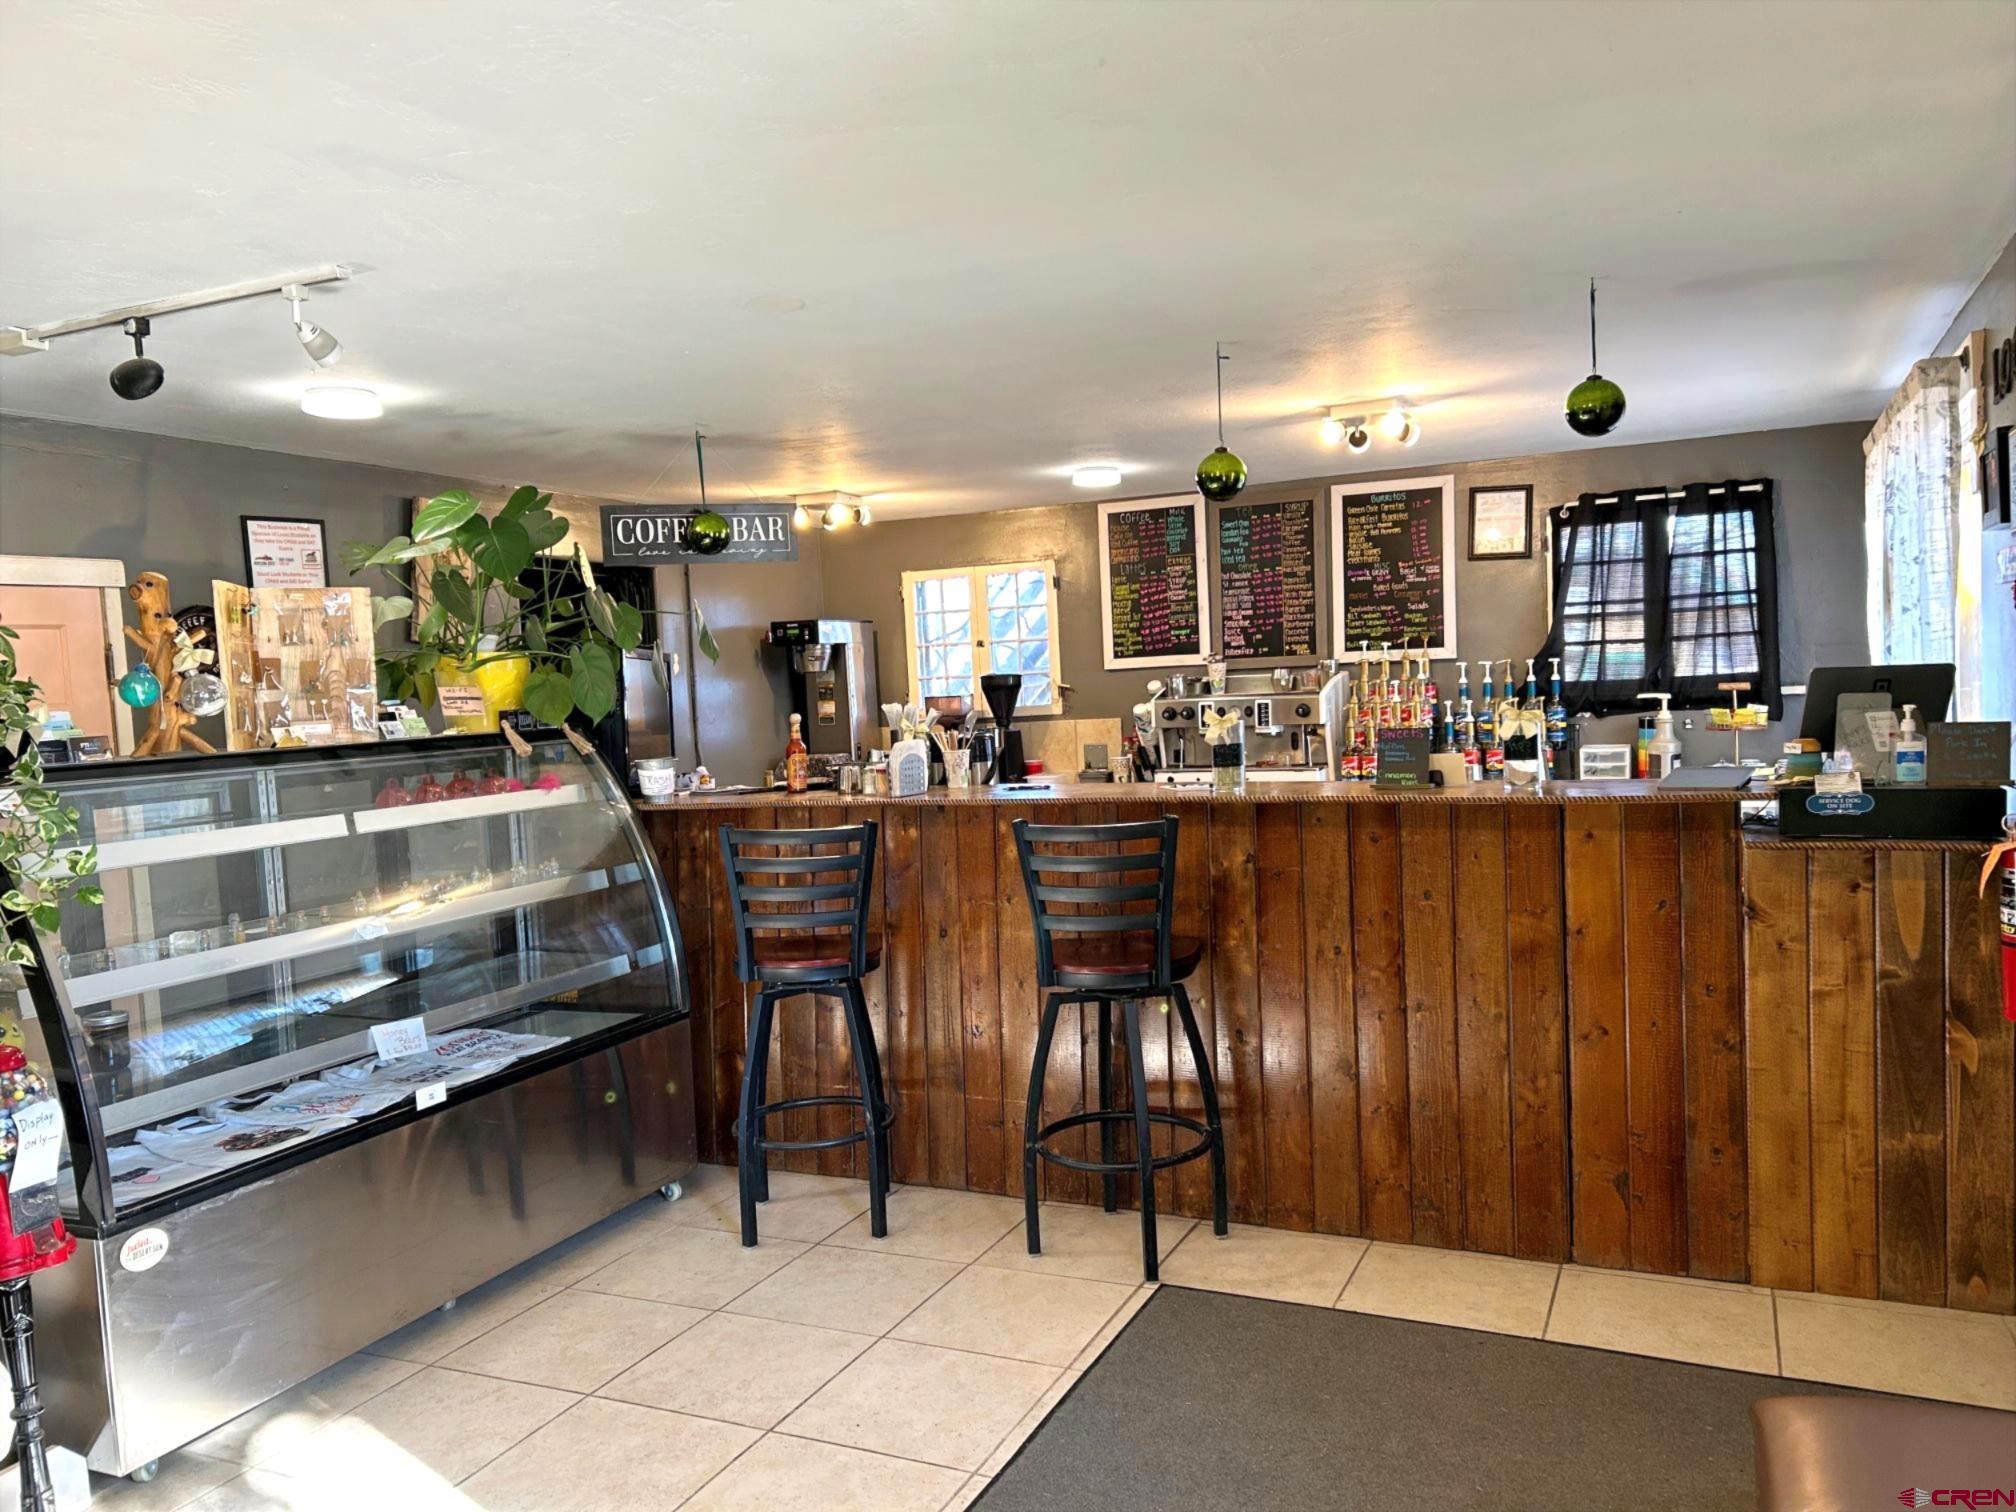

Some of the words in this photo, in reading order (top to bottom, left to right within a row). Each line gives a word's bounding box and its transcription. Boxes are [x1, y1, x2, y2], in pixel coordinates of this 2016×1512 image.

[1993, 326, 2016, 405] LO
[616, 517, 693, 545] COFF
[732, 516, 785, 542] BAR
[19, 1113, 53, 1133] Display
